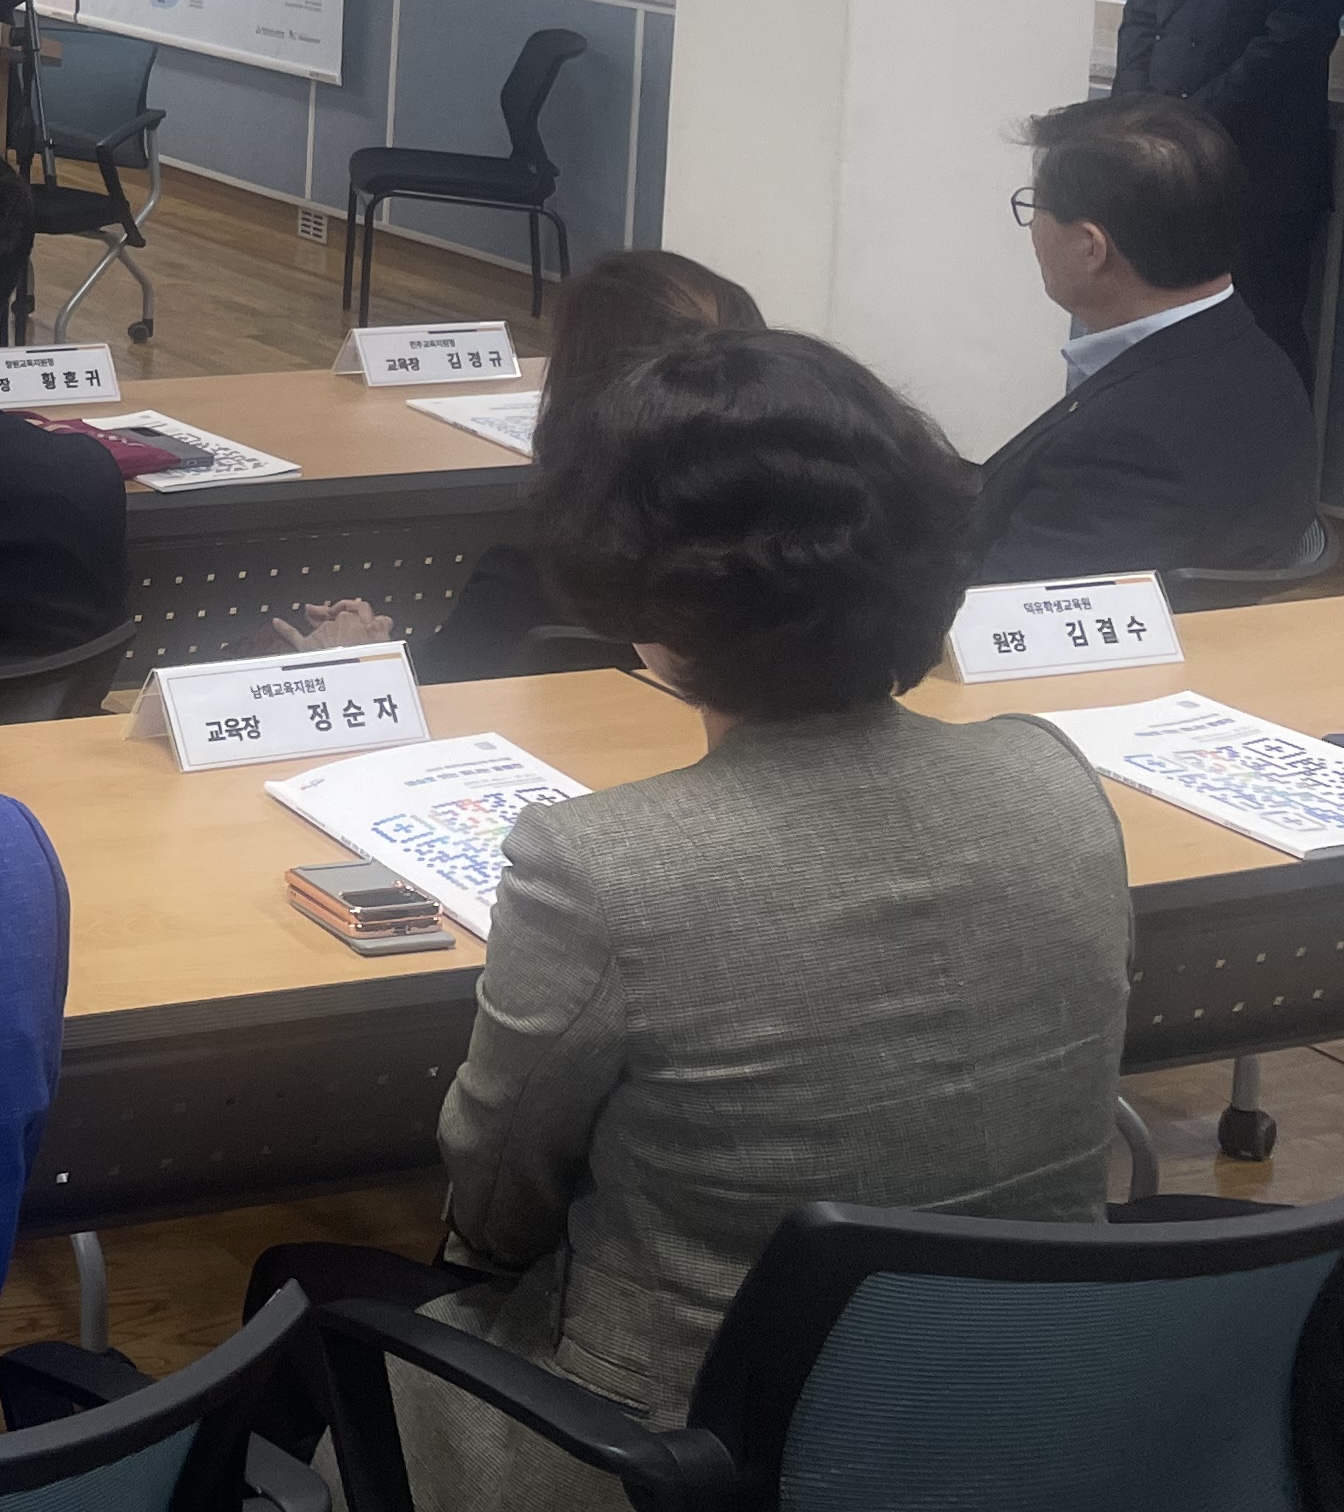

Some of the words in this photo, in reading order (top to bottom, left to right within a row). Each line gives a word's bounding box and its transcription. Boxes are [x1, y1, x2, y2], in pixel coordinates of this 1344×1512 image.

[385, 357, 420, 372] 교육장
[992, 630, 1027, 654] 원장
[249, 677, 327, 700] 남해교육지원청
[205, 715, 262, 743] 교육장
